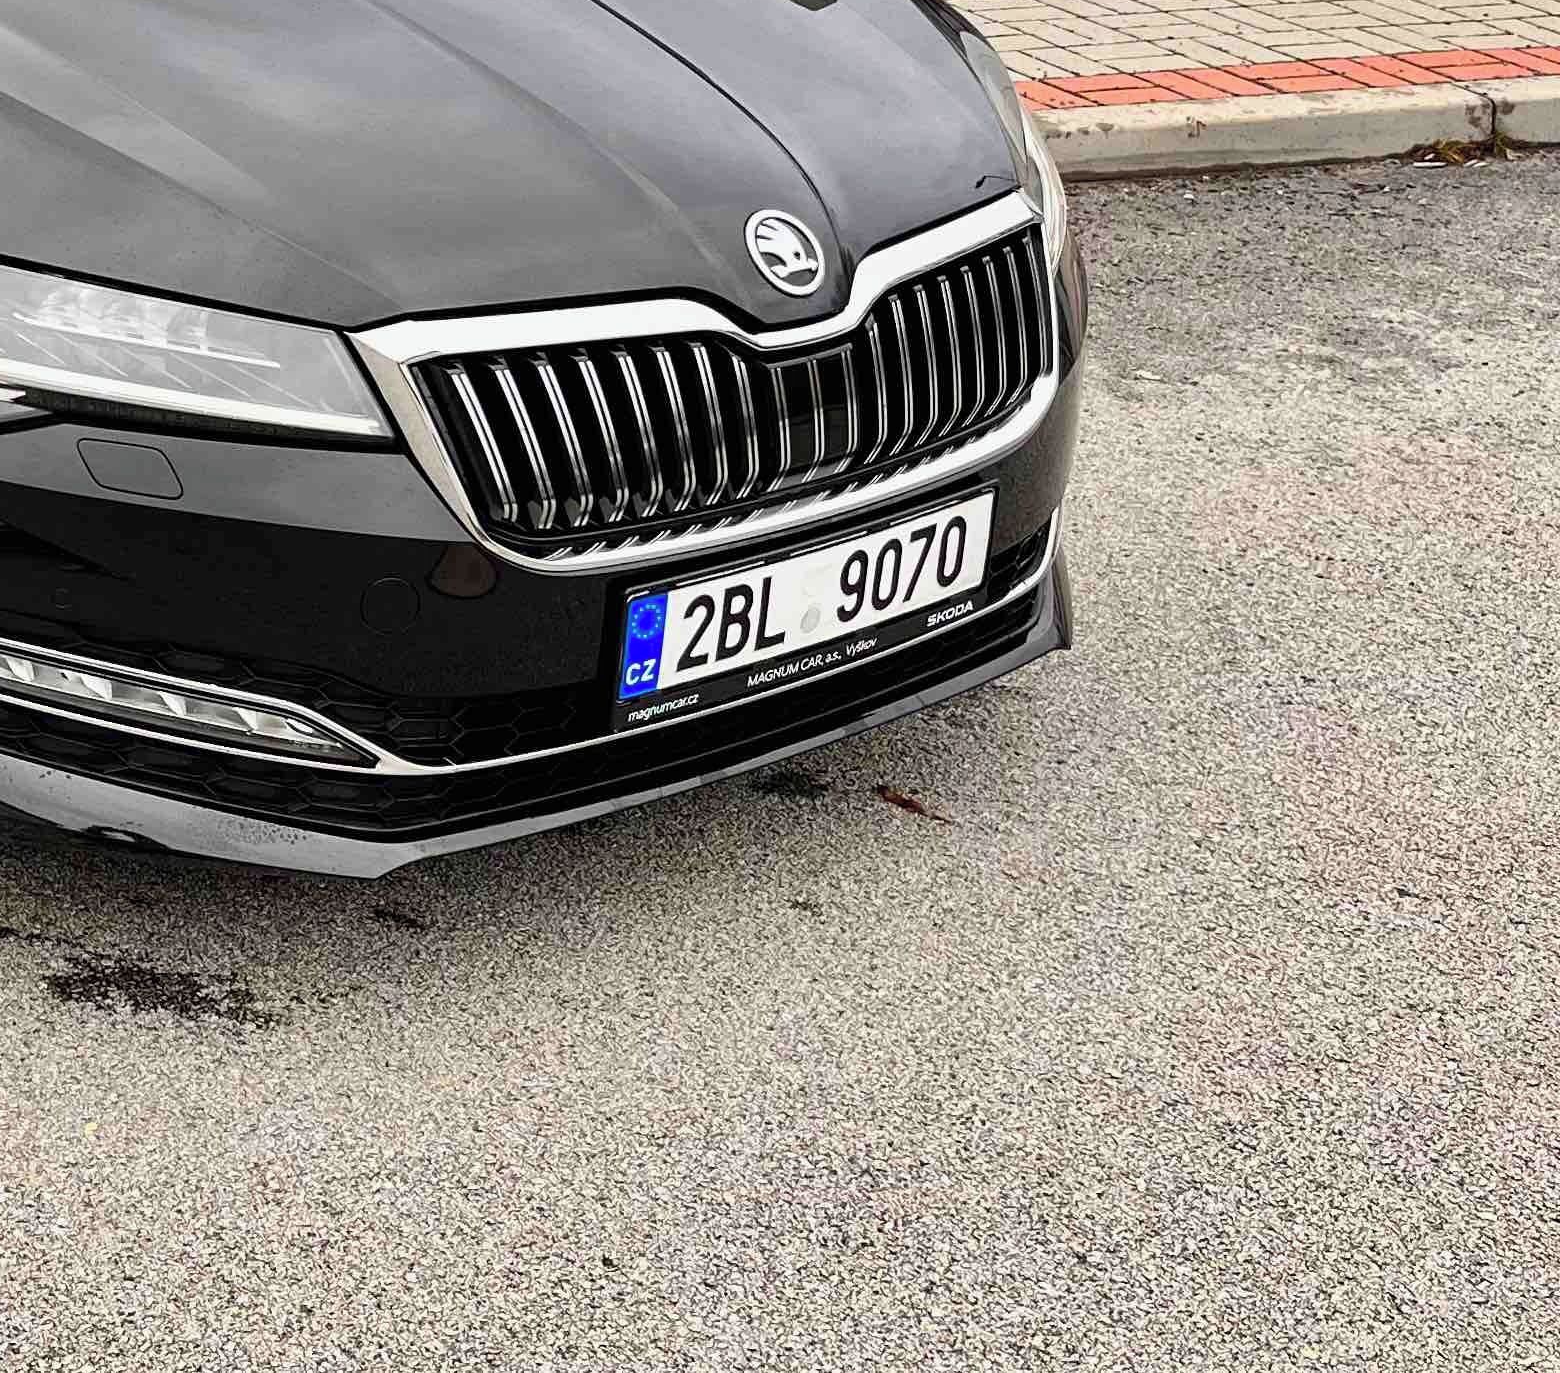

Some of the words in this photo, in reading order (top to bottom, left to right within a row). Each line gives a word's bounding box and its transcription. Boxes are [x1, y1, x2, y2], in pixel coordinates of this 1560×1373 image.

[675, 576, 786, 673] 2BL
[836, 515, 968, 623] 9070
[625, 658, 656, 686] CZ
[747, 662, 800, 687] MAGNUM
[627, 693, 699, 722] magnumcar.cz
